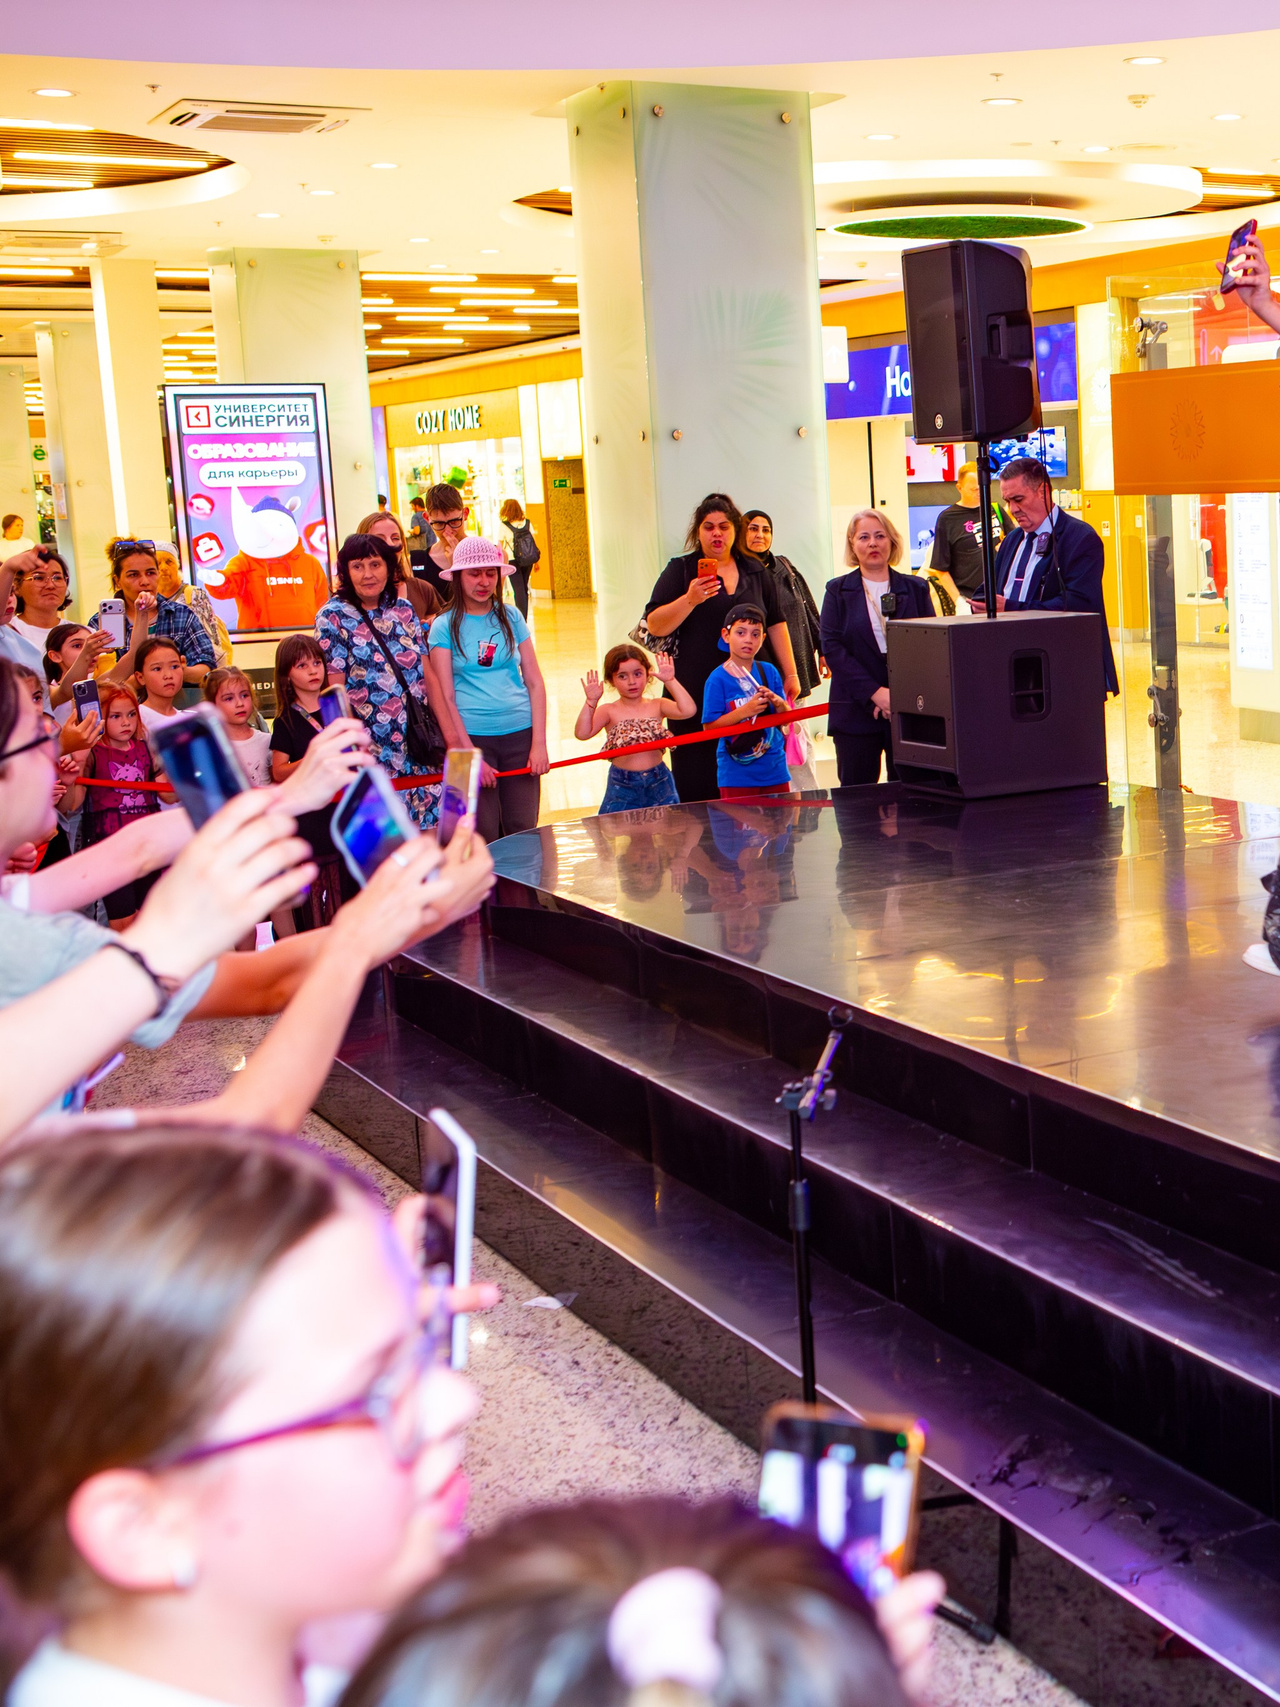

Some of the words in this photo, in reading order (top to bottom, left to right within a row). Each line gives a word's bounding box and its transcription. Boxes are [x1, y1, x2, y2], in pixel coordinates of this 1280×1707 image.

[214, 403, 309, 414] УНИВЕРСИТЕТ
[214, 414, 311, 428] СИНЕРГИЯ
[415, 409, 446, 435] COZY
[448, 404, 482, 432] HOME
[187, 441, 317, 460] ОБРАЗОВАНИЕ
[207, 469, 235, 480] для
[238, 468, 298, 480] карьеры
